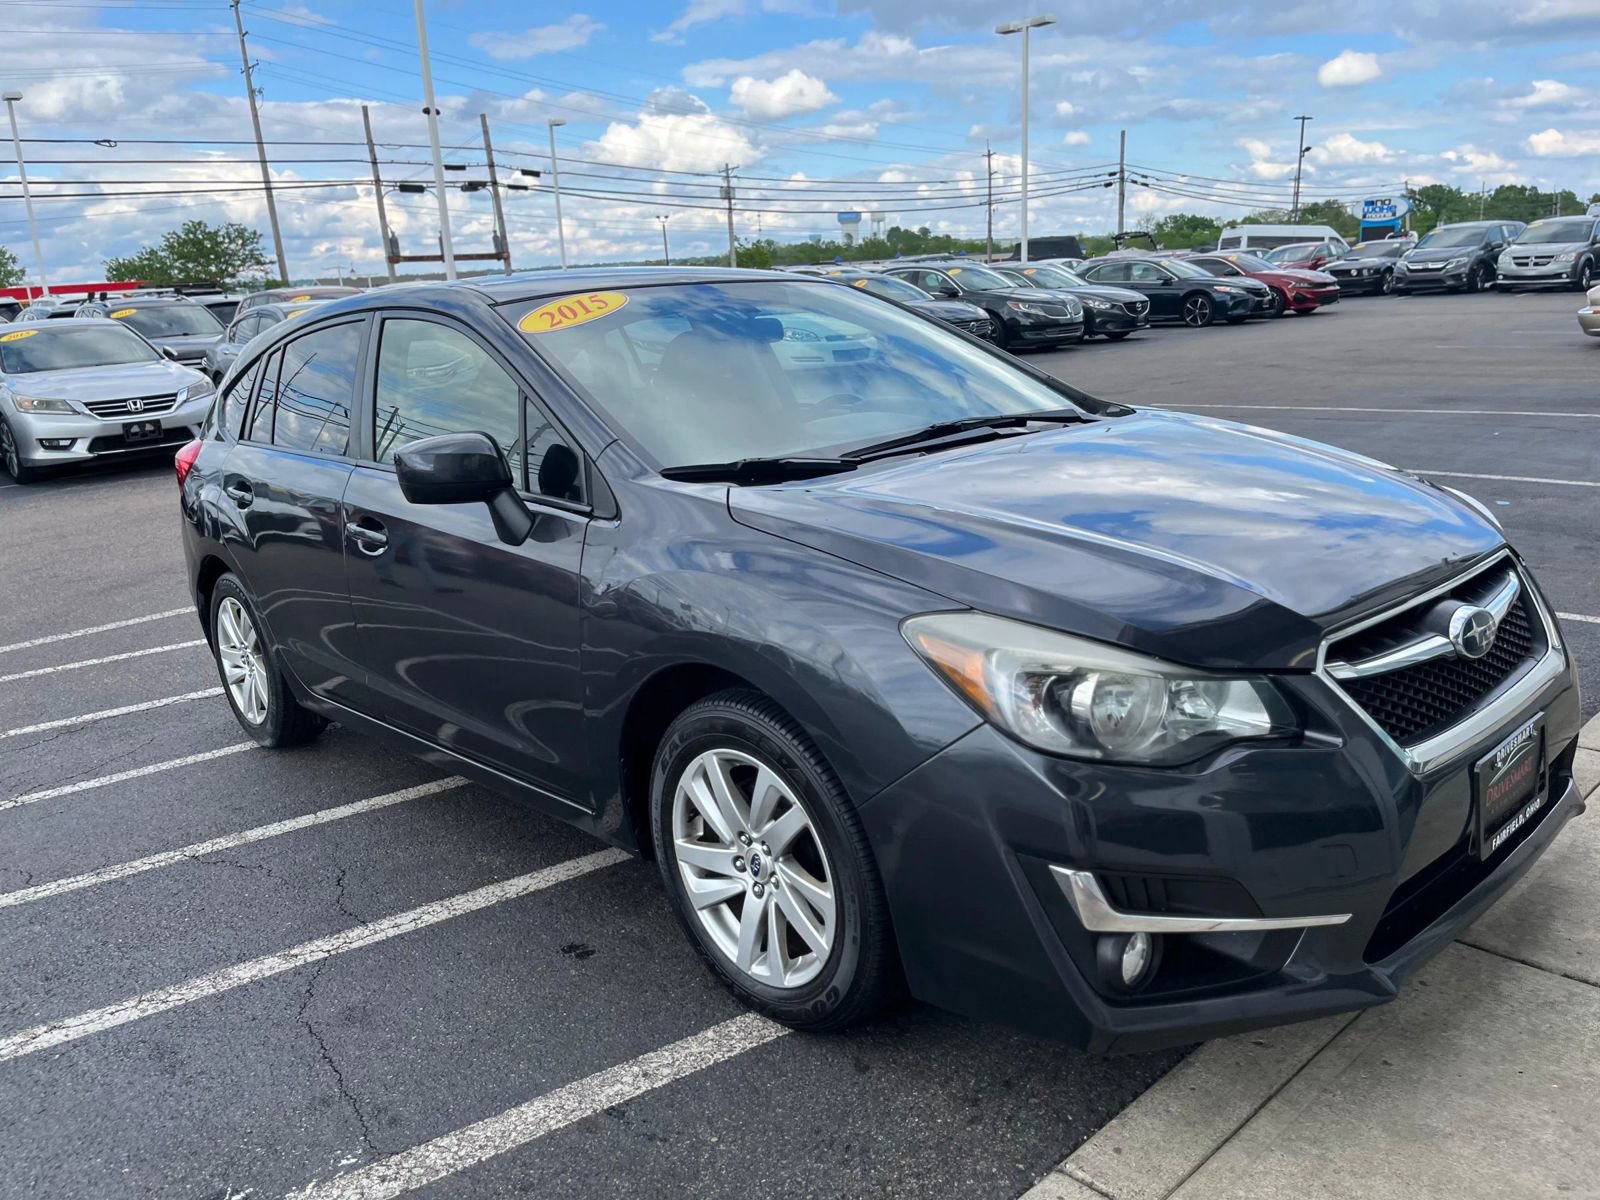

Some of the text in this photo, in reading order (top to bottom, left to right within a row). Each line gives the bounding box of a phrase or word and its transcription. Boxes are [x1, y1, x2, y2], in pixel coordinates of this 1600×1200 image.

[539, 294, 609, 329] 2015
[1496, 724, 1534, 762] DRIVESMART
[1492, 798, 1541, 851] FAIRFIELD, OHIO
